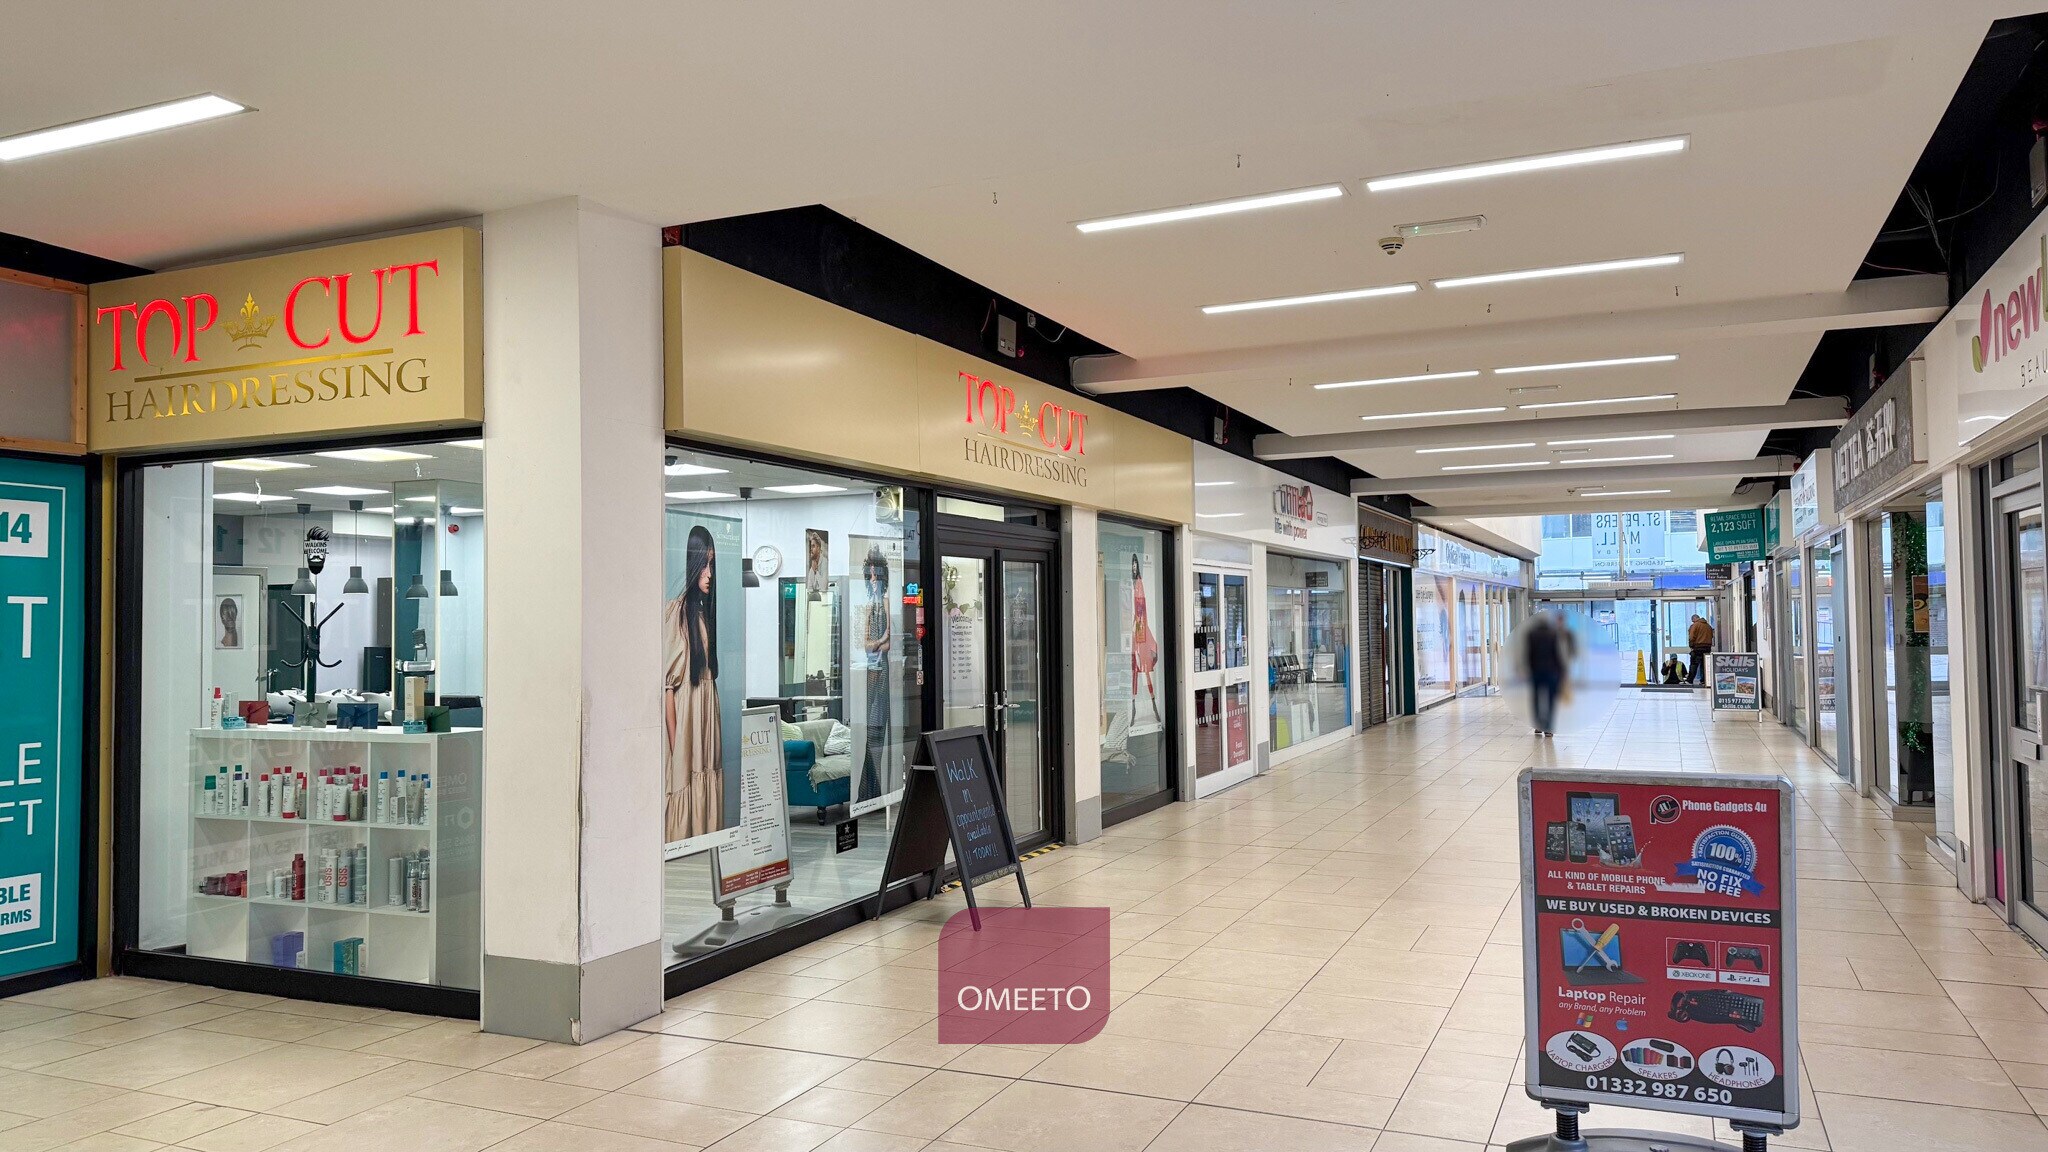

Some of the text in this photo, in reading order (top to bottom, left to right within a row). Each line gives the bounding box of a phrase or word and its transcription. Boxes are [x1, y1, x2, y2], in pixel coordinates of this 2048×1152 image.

[96, 259, 439, 372] TOP CUT
[106, 357, 430, 424] HAIRDRESSING
[958, 370, 1089, 456] TOP CUT
[963, 437, 1088, 487] HAIRDRESSING
[1711, 519, 1756, 534] 2,123 SQFT
[1715, 655, 1755, 667] Skills
[750, 729, 771, 746] CUT
[742, 745, 772, 758] RESSING
[956, 801, 996, 829] appointments
[1682, 799, 1767, 813] Phone Gadgets 4u
[966, 823, 991, 842] available
[1698, 830, 1752, 866] SATISFACTION GUARANTEED
[1709, 842, 1743, 864] 100%
[1547, 870, 1666, 885] ALL KIND OF MOBILE PHONE
[1691, 861, 1751, 880] SATISFACTION GUARANTEED
[1697, 868, 1743, 888] NO FIX
[1567, 881, 1646, 895] & TABLET REPAIRS
[1718, 884, 1742, 897] FEE
[1546, 899, 1771, 924] WE BUY USED & BROKEN DEVICES
[1738, 975, 1761, 983] PS4
[1558, 985, 1647, 1006] Laptop Repair
[1558, 1001, 1647, 1017] any Brand, any Problem
[1548, 1049, 1616, 1071] LAPTOP CHARGERS
[1637, 1067, 1678, 1080] SPEAKERS
[1708, 1071, 1766, 1088] HEADPHONES
[1585, 1074, 1732, 1104] 01332 987 650
